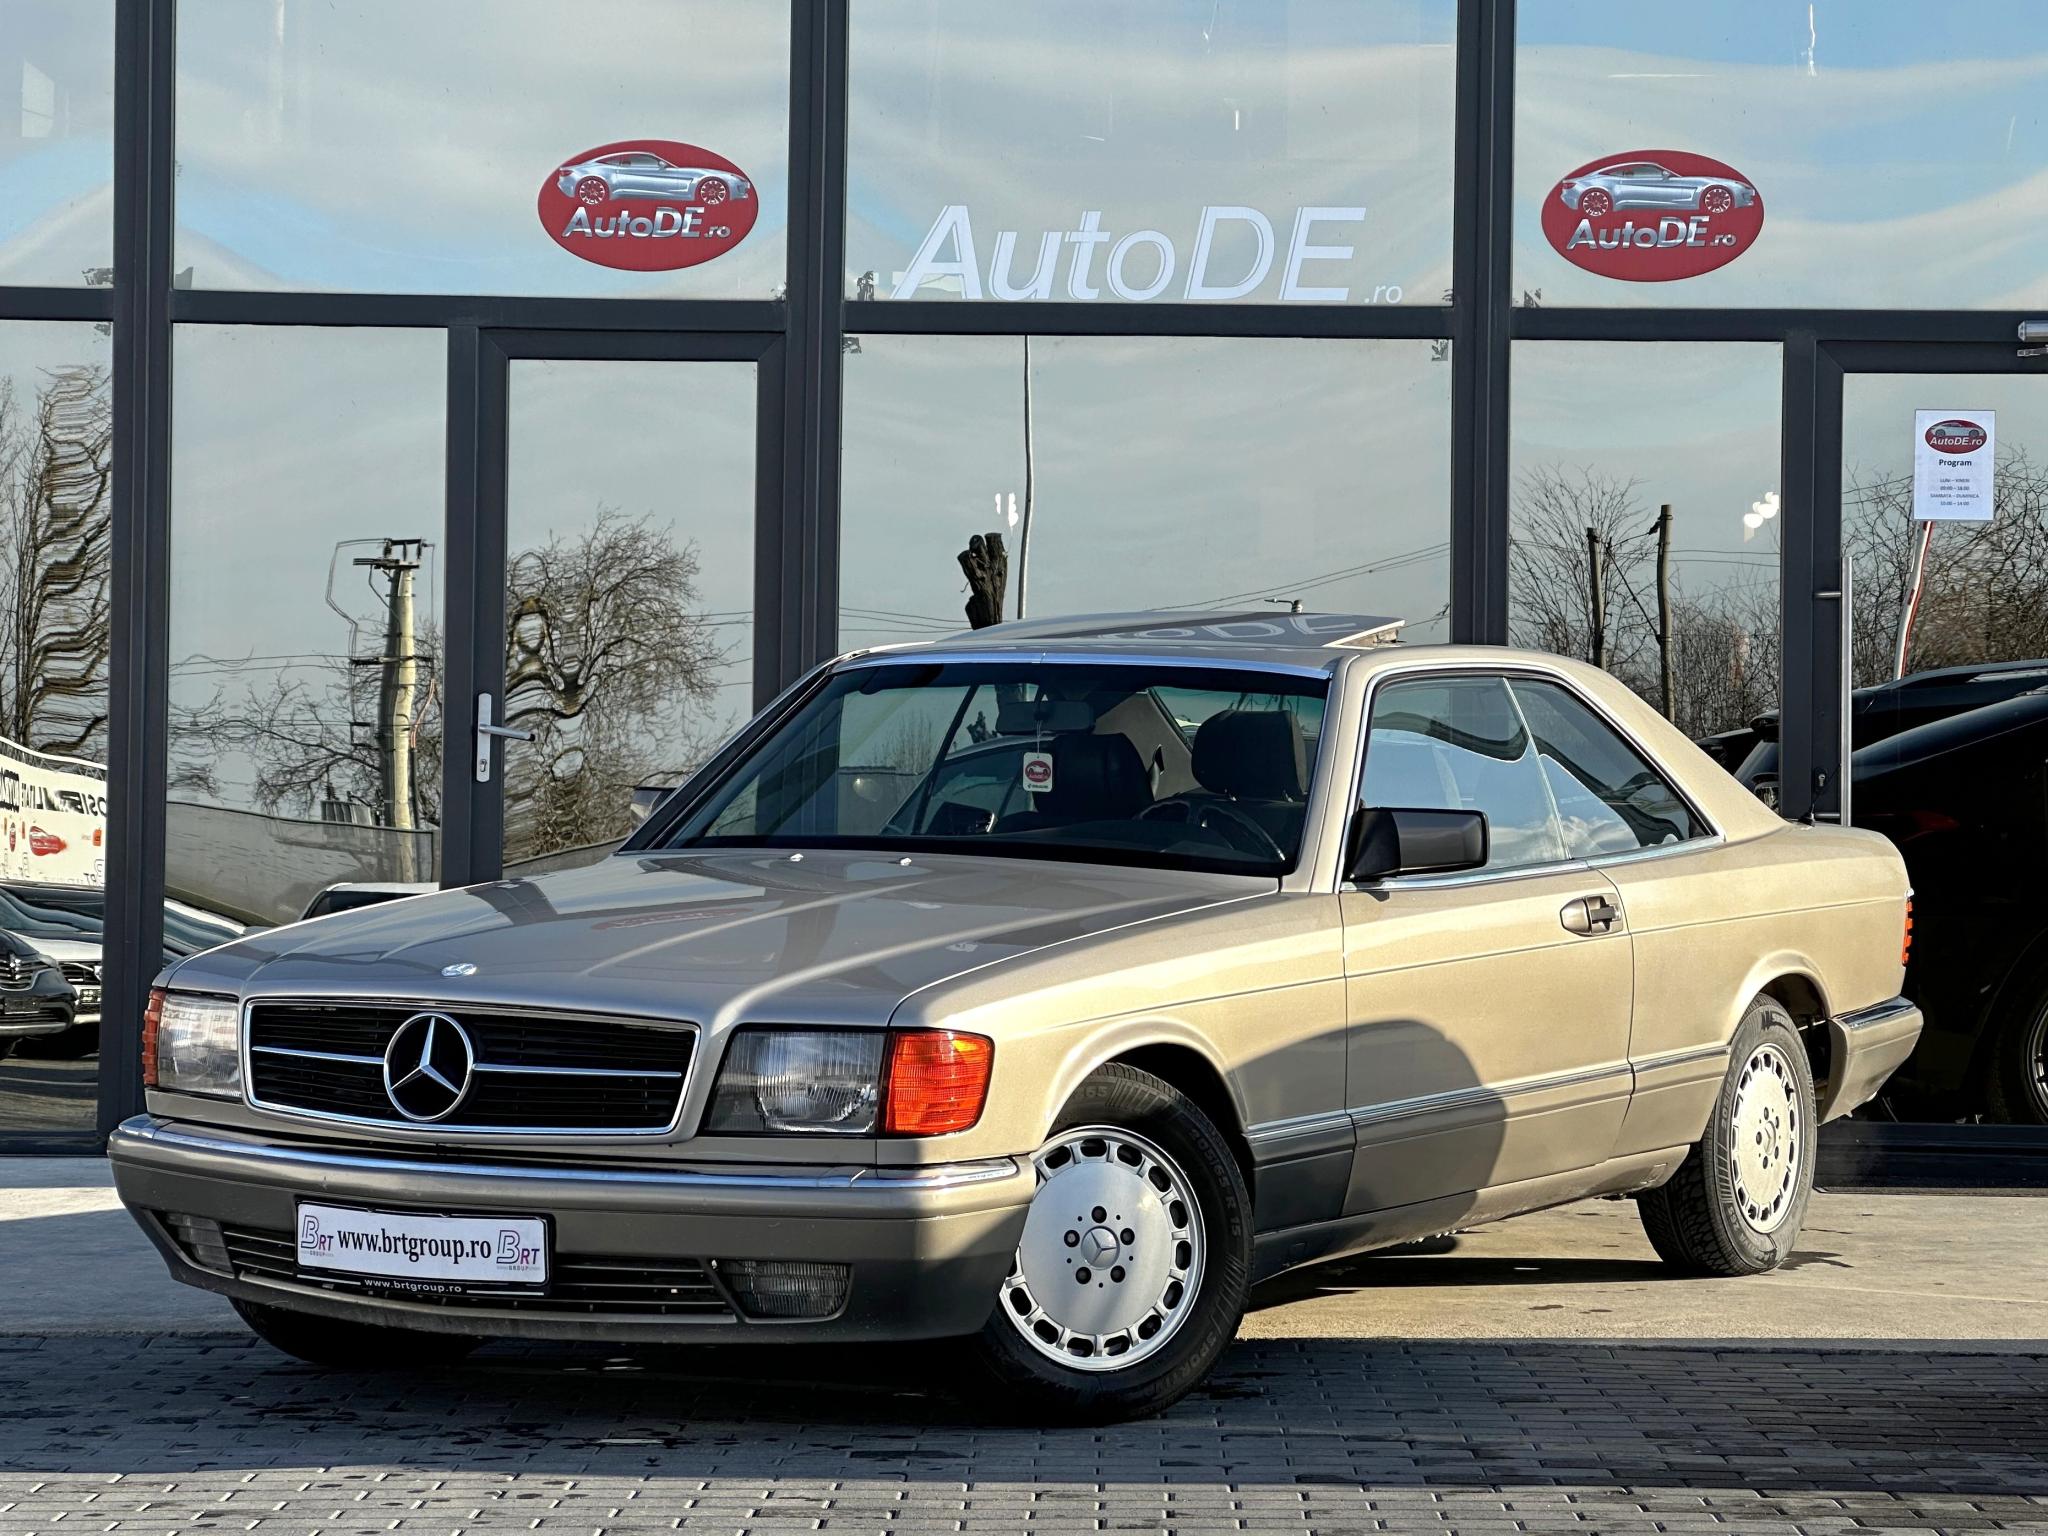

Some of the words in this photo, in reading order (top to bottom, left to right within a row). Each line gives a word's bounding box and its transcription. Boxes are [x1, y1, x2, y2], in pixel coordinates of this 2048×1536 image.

[561, 206, 731, 238] AutoDE.ro
[1566, 215, 1737, 250] AutoDE.ro
[1930, 436, 1983, 446] AutoDE.ro
[1938, 458, 1972, 468] Program
[337, 1228, 491, 1264] www.brtgroup.ro
[364, 1279, 462, 1293] www.brtgroup.ro
